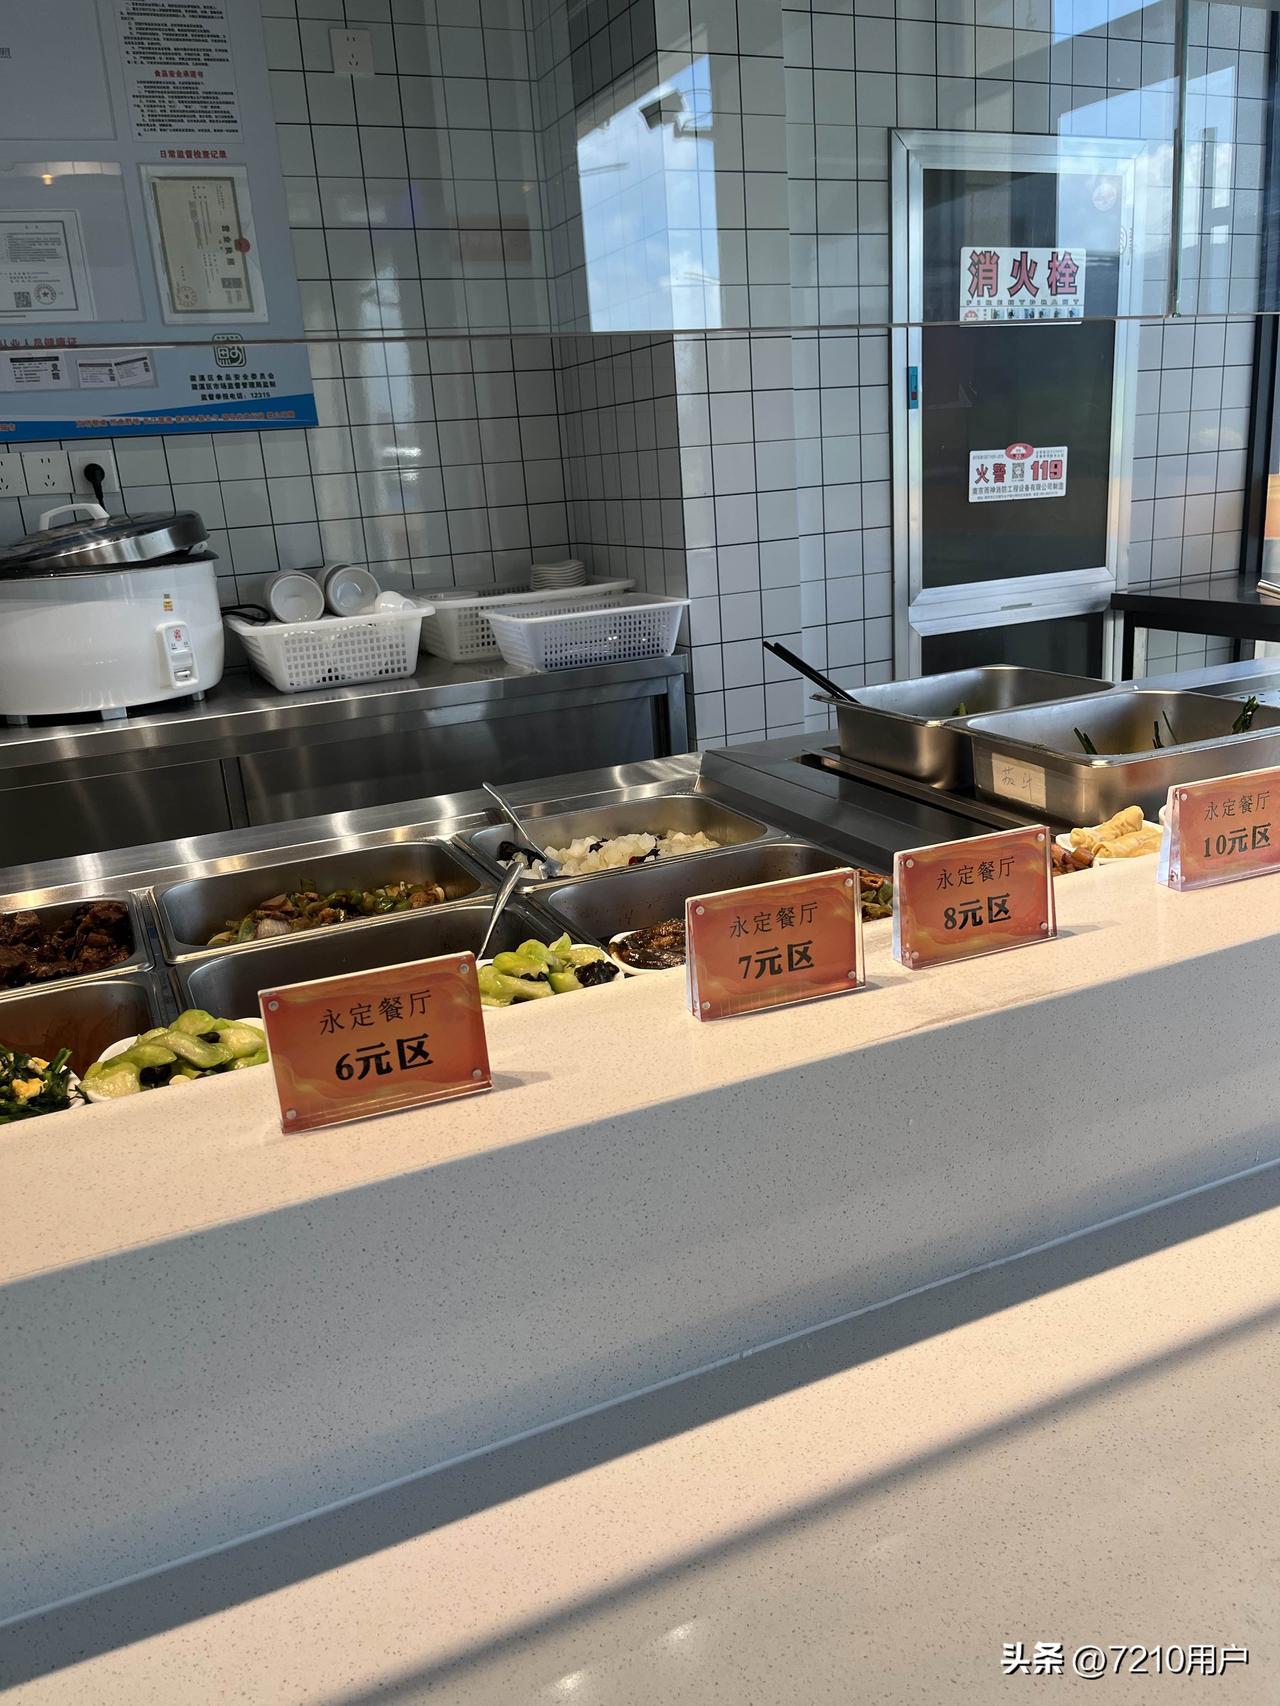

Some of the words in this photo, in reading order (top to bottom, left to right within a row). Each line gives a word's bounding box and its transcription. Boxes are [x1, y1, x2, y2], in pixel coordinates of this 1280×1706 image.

[160, 150, 228, 159] 日常监督检查记录
[967, 249, 1080, 299] 消火栓
[974, 462, 1007, 485] 火警
[1030, 459, 1063, 481] 119
[1204, 790, 1271, 822] 永定餐厅
[1203, 822, 1272, 859] 10元区
[935, 855, 1016, 891] 永定餐厅
[728, 901, 819, 939] 永定餐厅
[943, 892, 1013, 931] 8元区
[737, 939, 815, 980] 7元区
[319, 989, 432, 1036] 永定餐厅
[335, 1033, 434, 1081] 6元区
